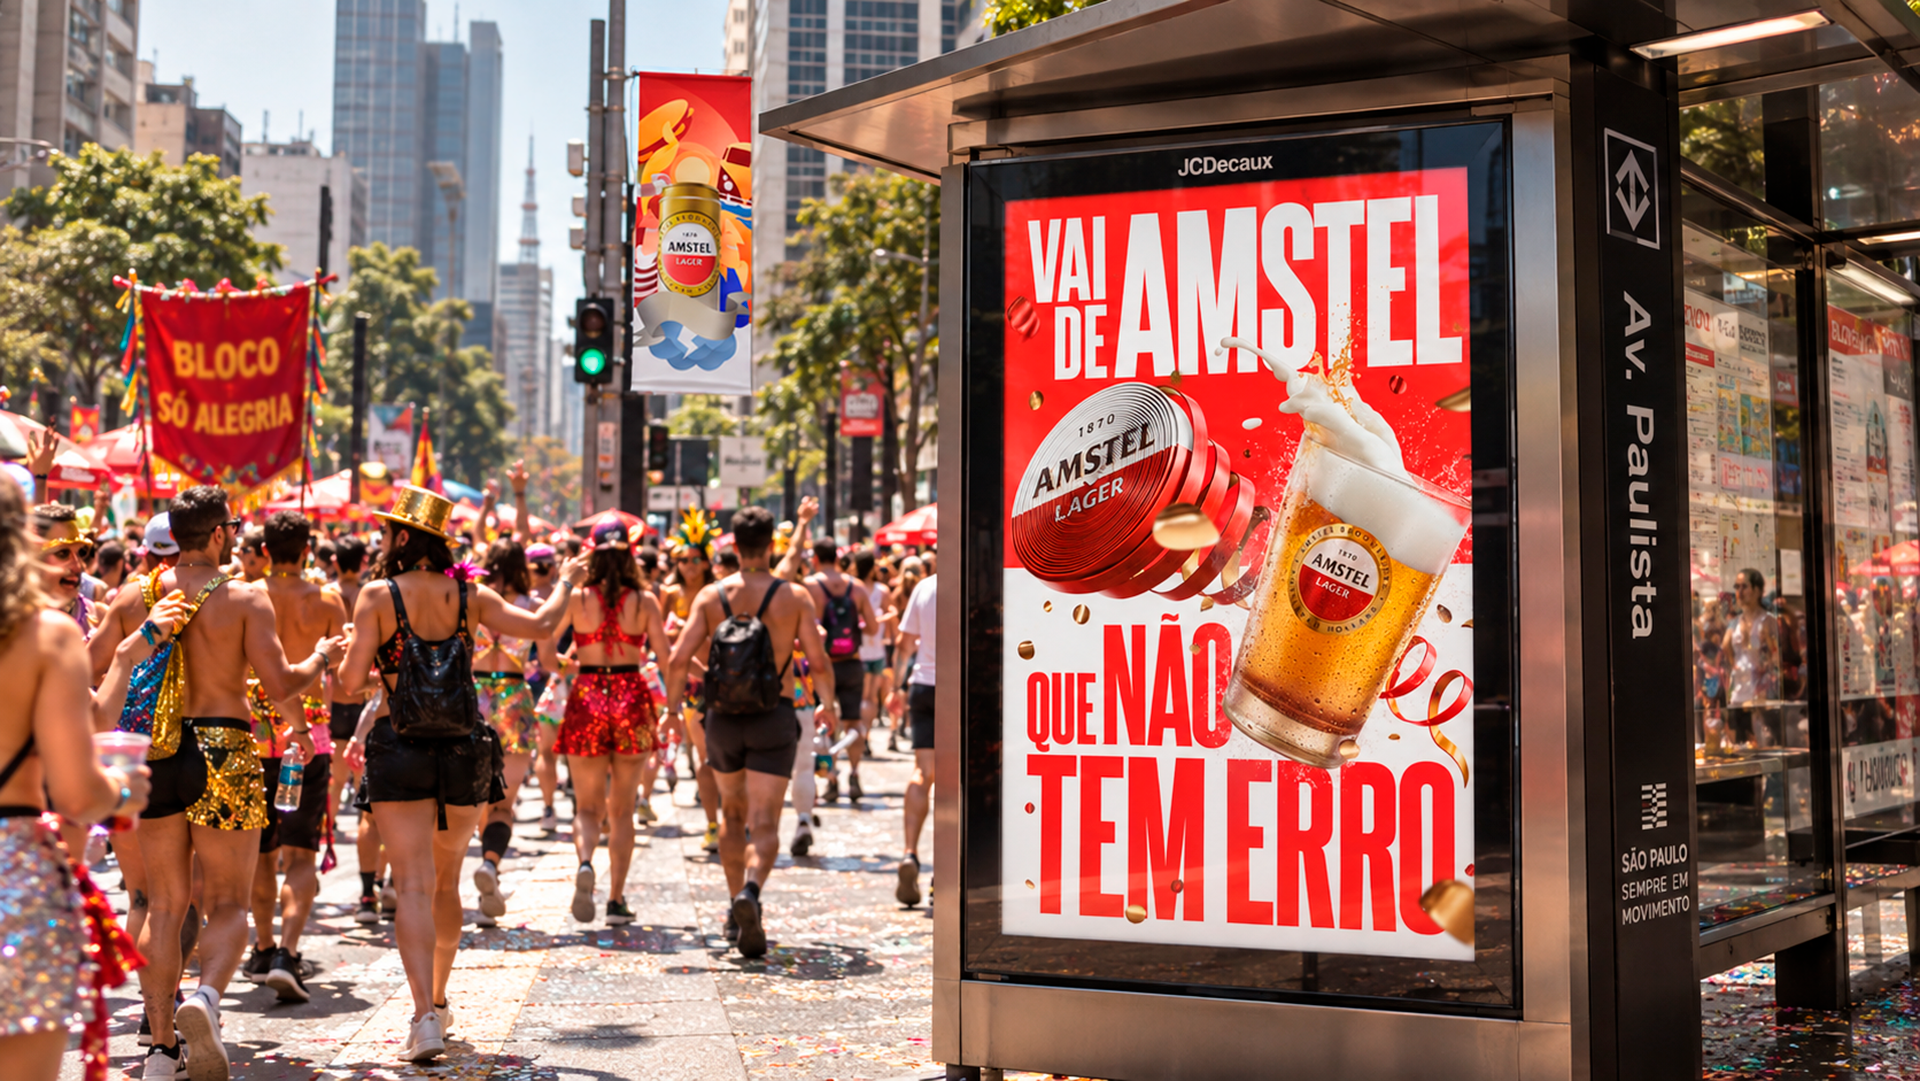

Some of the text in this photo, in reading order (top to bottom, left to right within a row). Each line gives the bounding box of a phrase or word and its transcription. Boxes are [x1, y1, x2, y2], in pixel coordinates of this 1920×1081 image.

[1177, 155, 1273, 177] JCDecaux
[667, 241, 712, 253] AMSTEL
[675, 257, 703, 266] LAGER
[1027, 216, 1106, 303] VAI
[1114, 194, 1463, 379] AMSTEL
[173, 336, 280, 380] BLOCO
[1054, 304, 1107, 380] DE
[156, 389, 295, 436] SÓ ALEGRIA
[1078, 413, 1116, 438] 1870
[1032, 422, 1156, 499] AMSTEL
[1623, 290, 1657, 640] Av. Paulista
[1054, 476, 1124, 523] LAGER
[1312, 553, 1370, 589] AMSTEL
[1315, 576, 1350, 600] LAGER
[1026, 613, 1232, 752] QUE NÃO
[1026, 754, 1456, 936] TEM ERRO
[1621, 843, 1688, 874] SÃO PAULO
[1621, 871, 1689, 901] SEMPRE EM
[1622, 895, 1690, 926] MOVIMENTO
